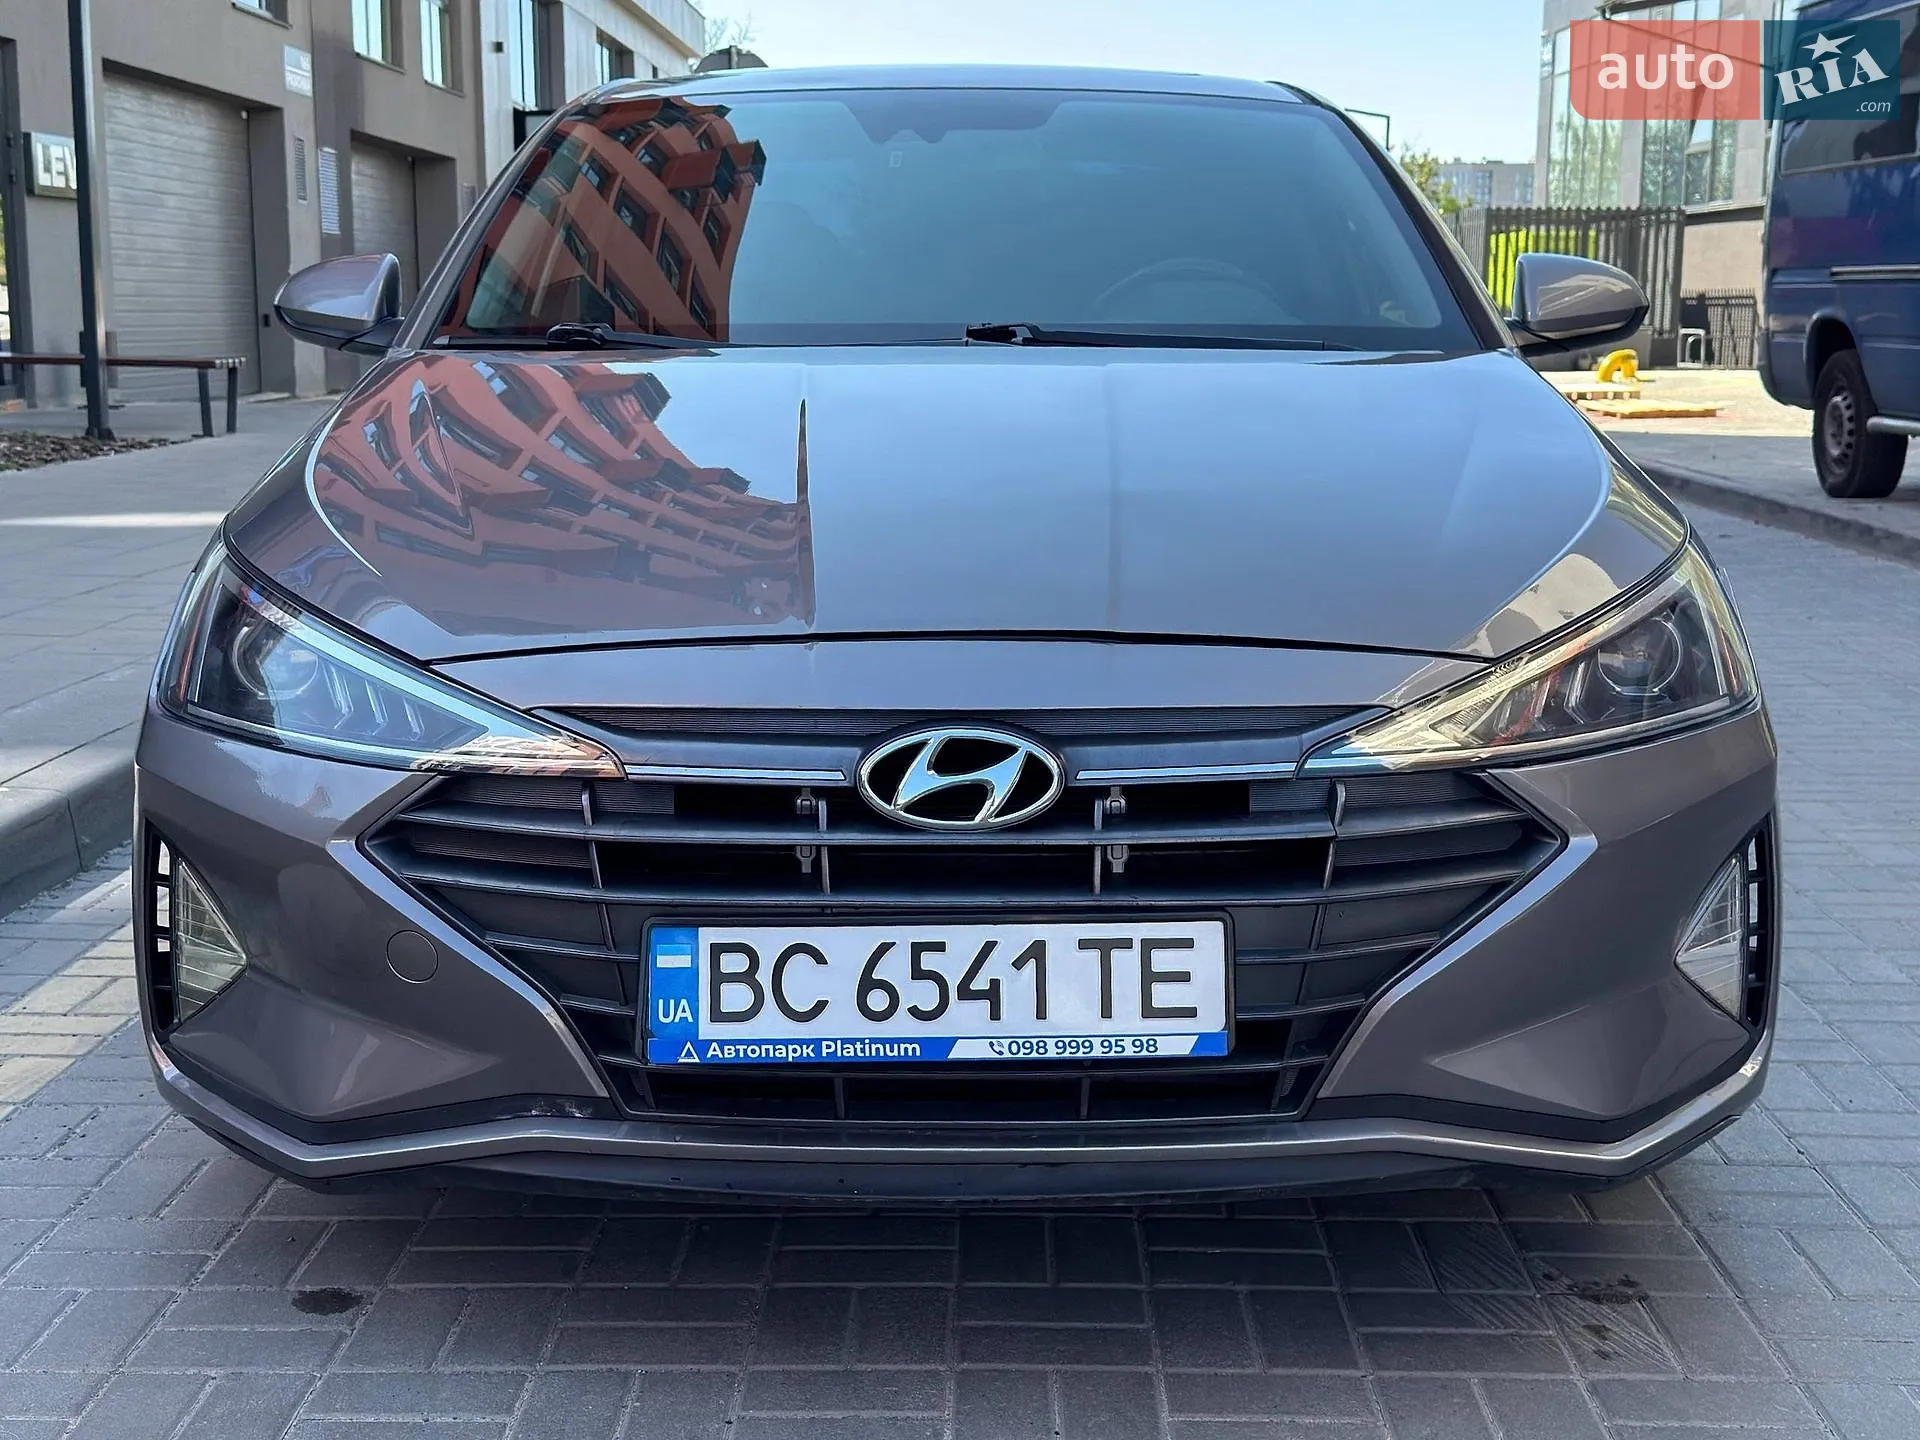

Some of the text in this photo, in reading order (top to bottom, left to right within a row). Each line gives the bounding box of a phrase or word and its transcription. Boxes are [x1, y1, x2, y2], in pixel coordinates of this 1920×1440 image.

[709, 937, 1198, 1023] BC 6541 TE
[658, 998, 694, 1023] UA
[706, 1039, 921, 1061] Автопарк Platinum
[1007, 1038, 1159, 1056] 098 999 95 98
